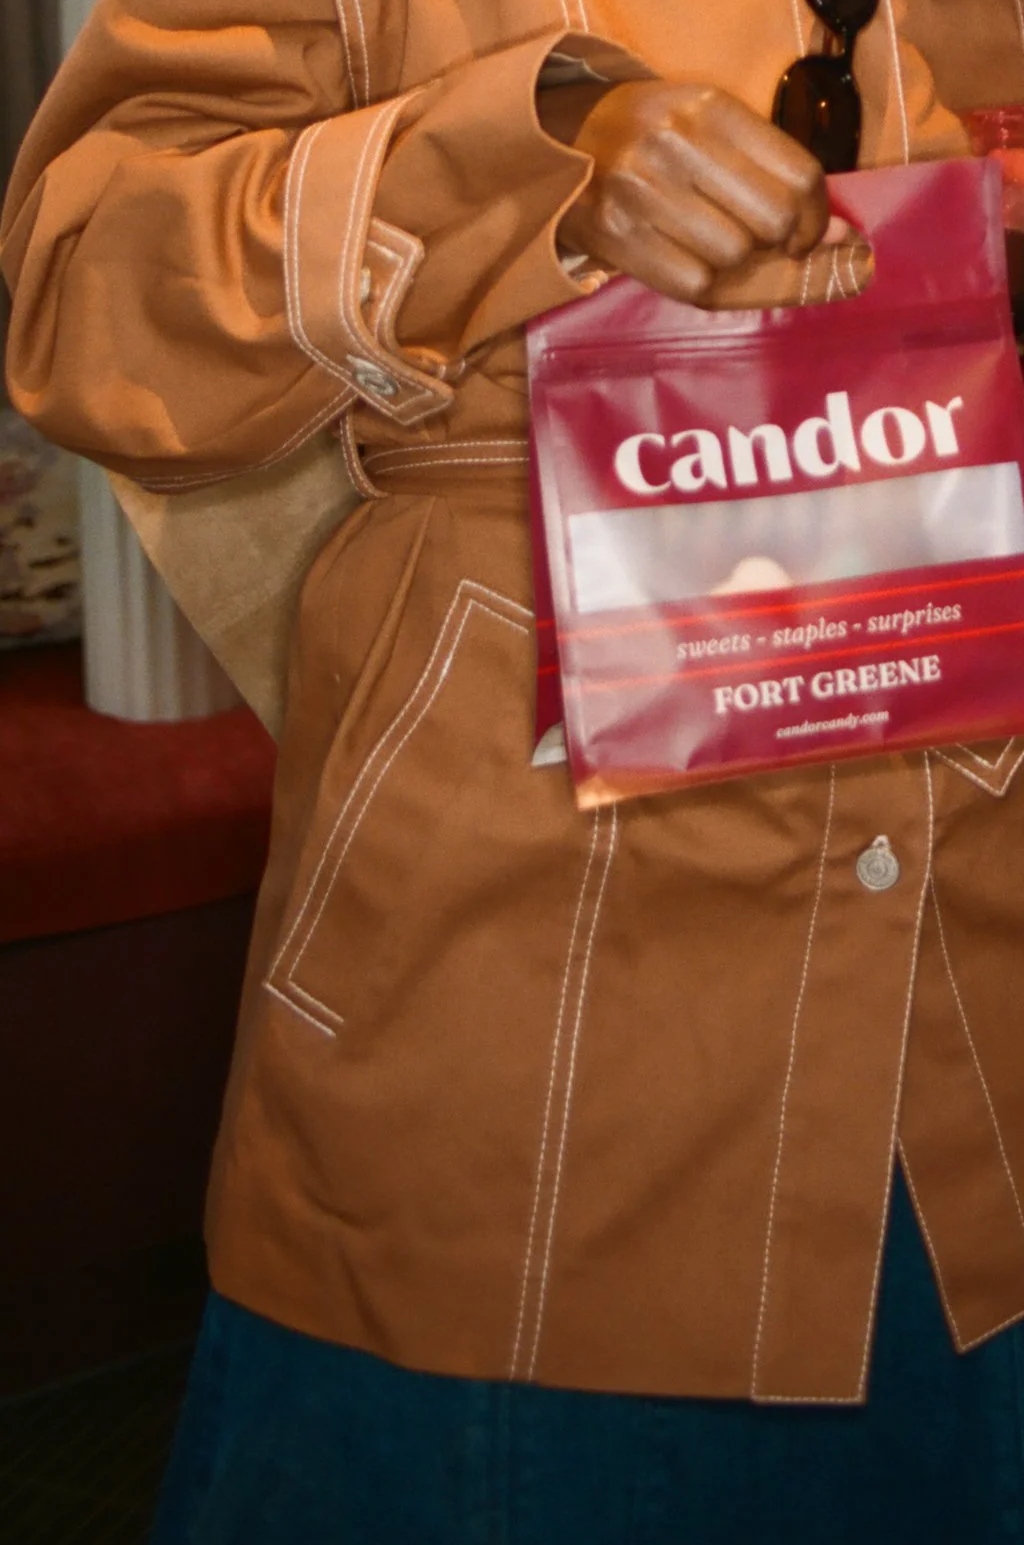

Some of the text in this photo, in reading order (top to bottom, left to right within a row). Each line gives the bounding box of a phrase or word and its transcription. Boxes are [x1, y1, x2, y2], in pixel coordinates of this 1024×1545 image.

[614, 390, 964, 495] candor
[676, 633, 750, 660] sweets
[772, 617, 847, 650] staples
[867, 602, 961, 634] surprises
[714, 655, 941, 714] FORT GREENE
[776, 710, 889, 739] candorcandy.com
